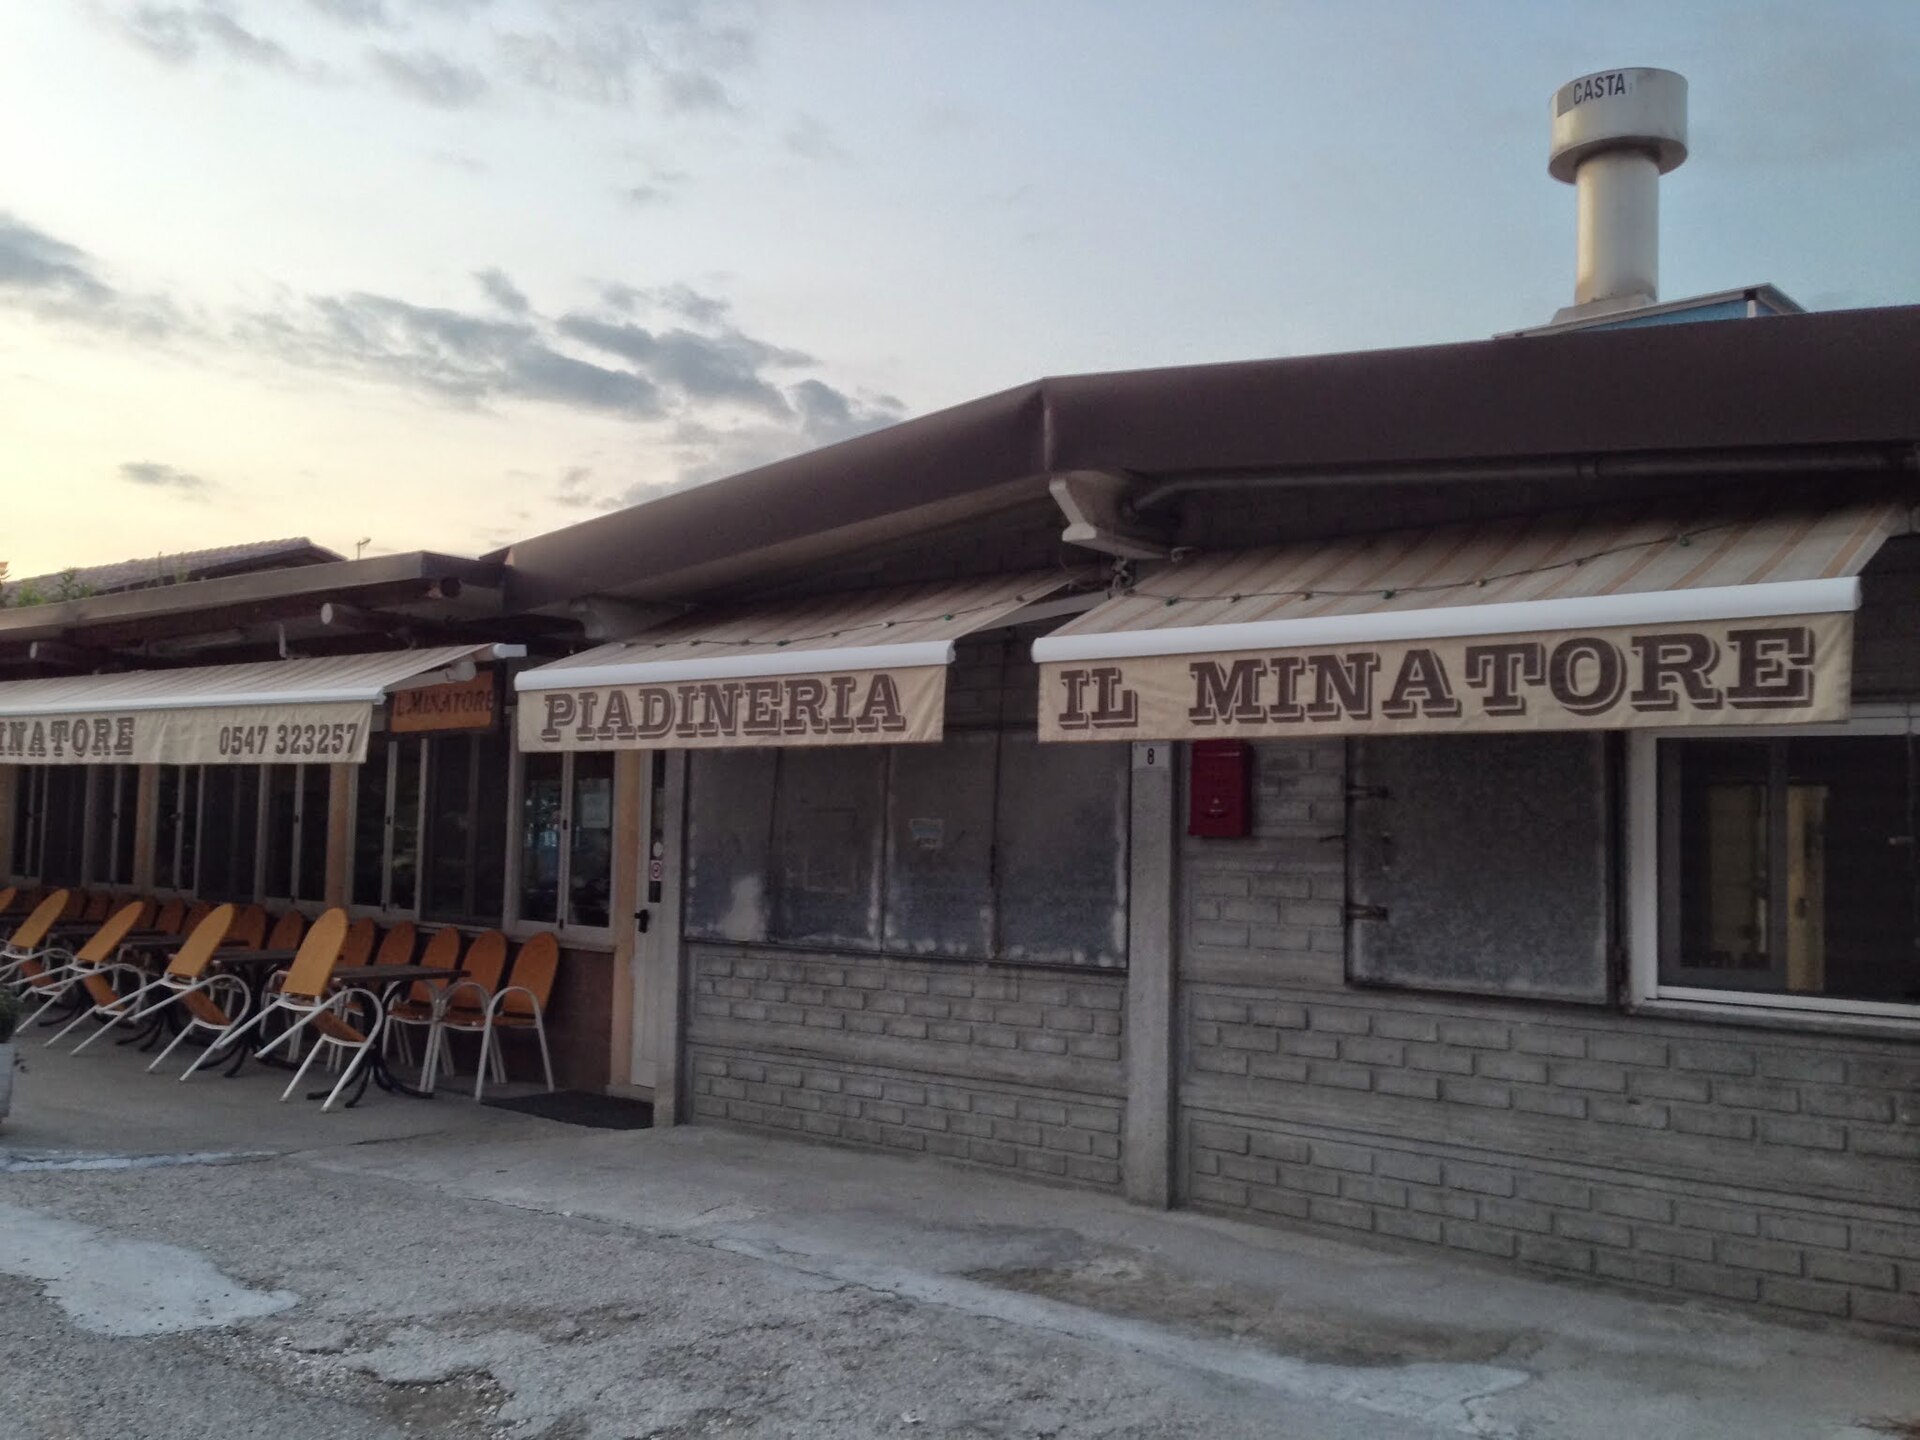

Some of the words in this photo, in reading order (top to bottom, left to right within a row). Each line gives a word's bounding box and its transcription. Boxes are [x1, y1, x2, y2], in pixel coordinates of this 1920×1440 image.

[1572, 73, 1626, 105] CASTA
[1058, 666, 1138, 730] IL
[1188, 626, 1816, 725] MINATORE
[541, 673, 907, 742] PIADINERIA
[219, 725, 269, 755] 0547
[275, 722, 359, 755] 323257
[1147, 748, 1155, 765] 8
